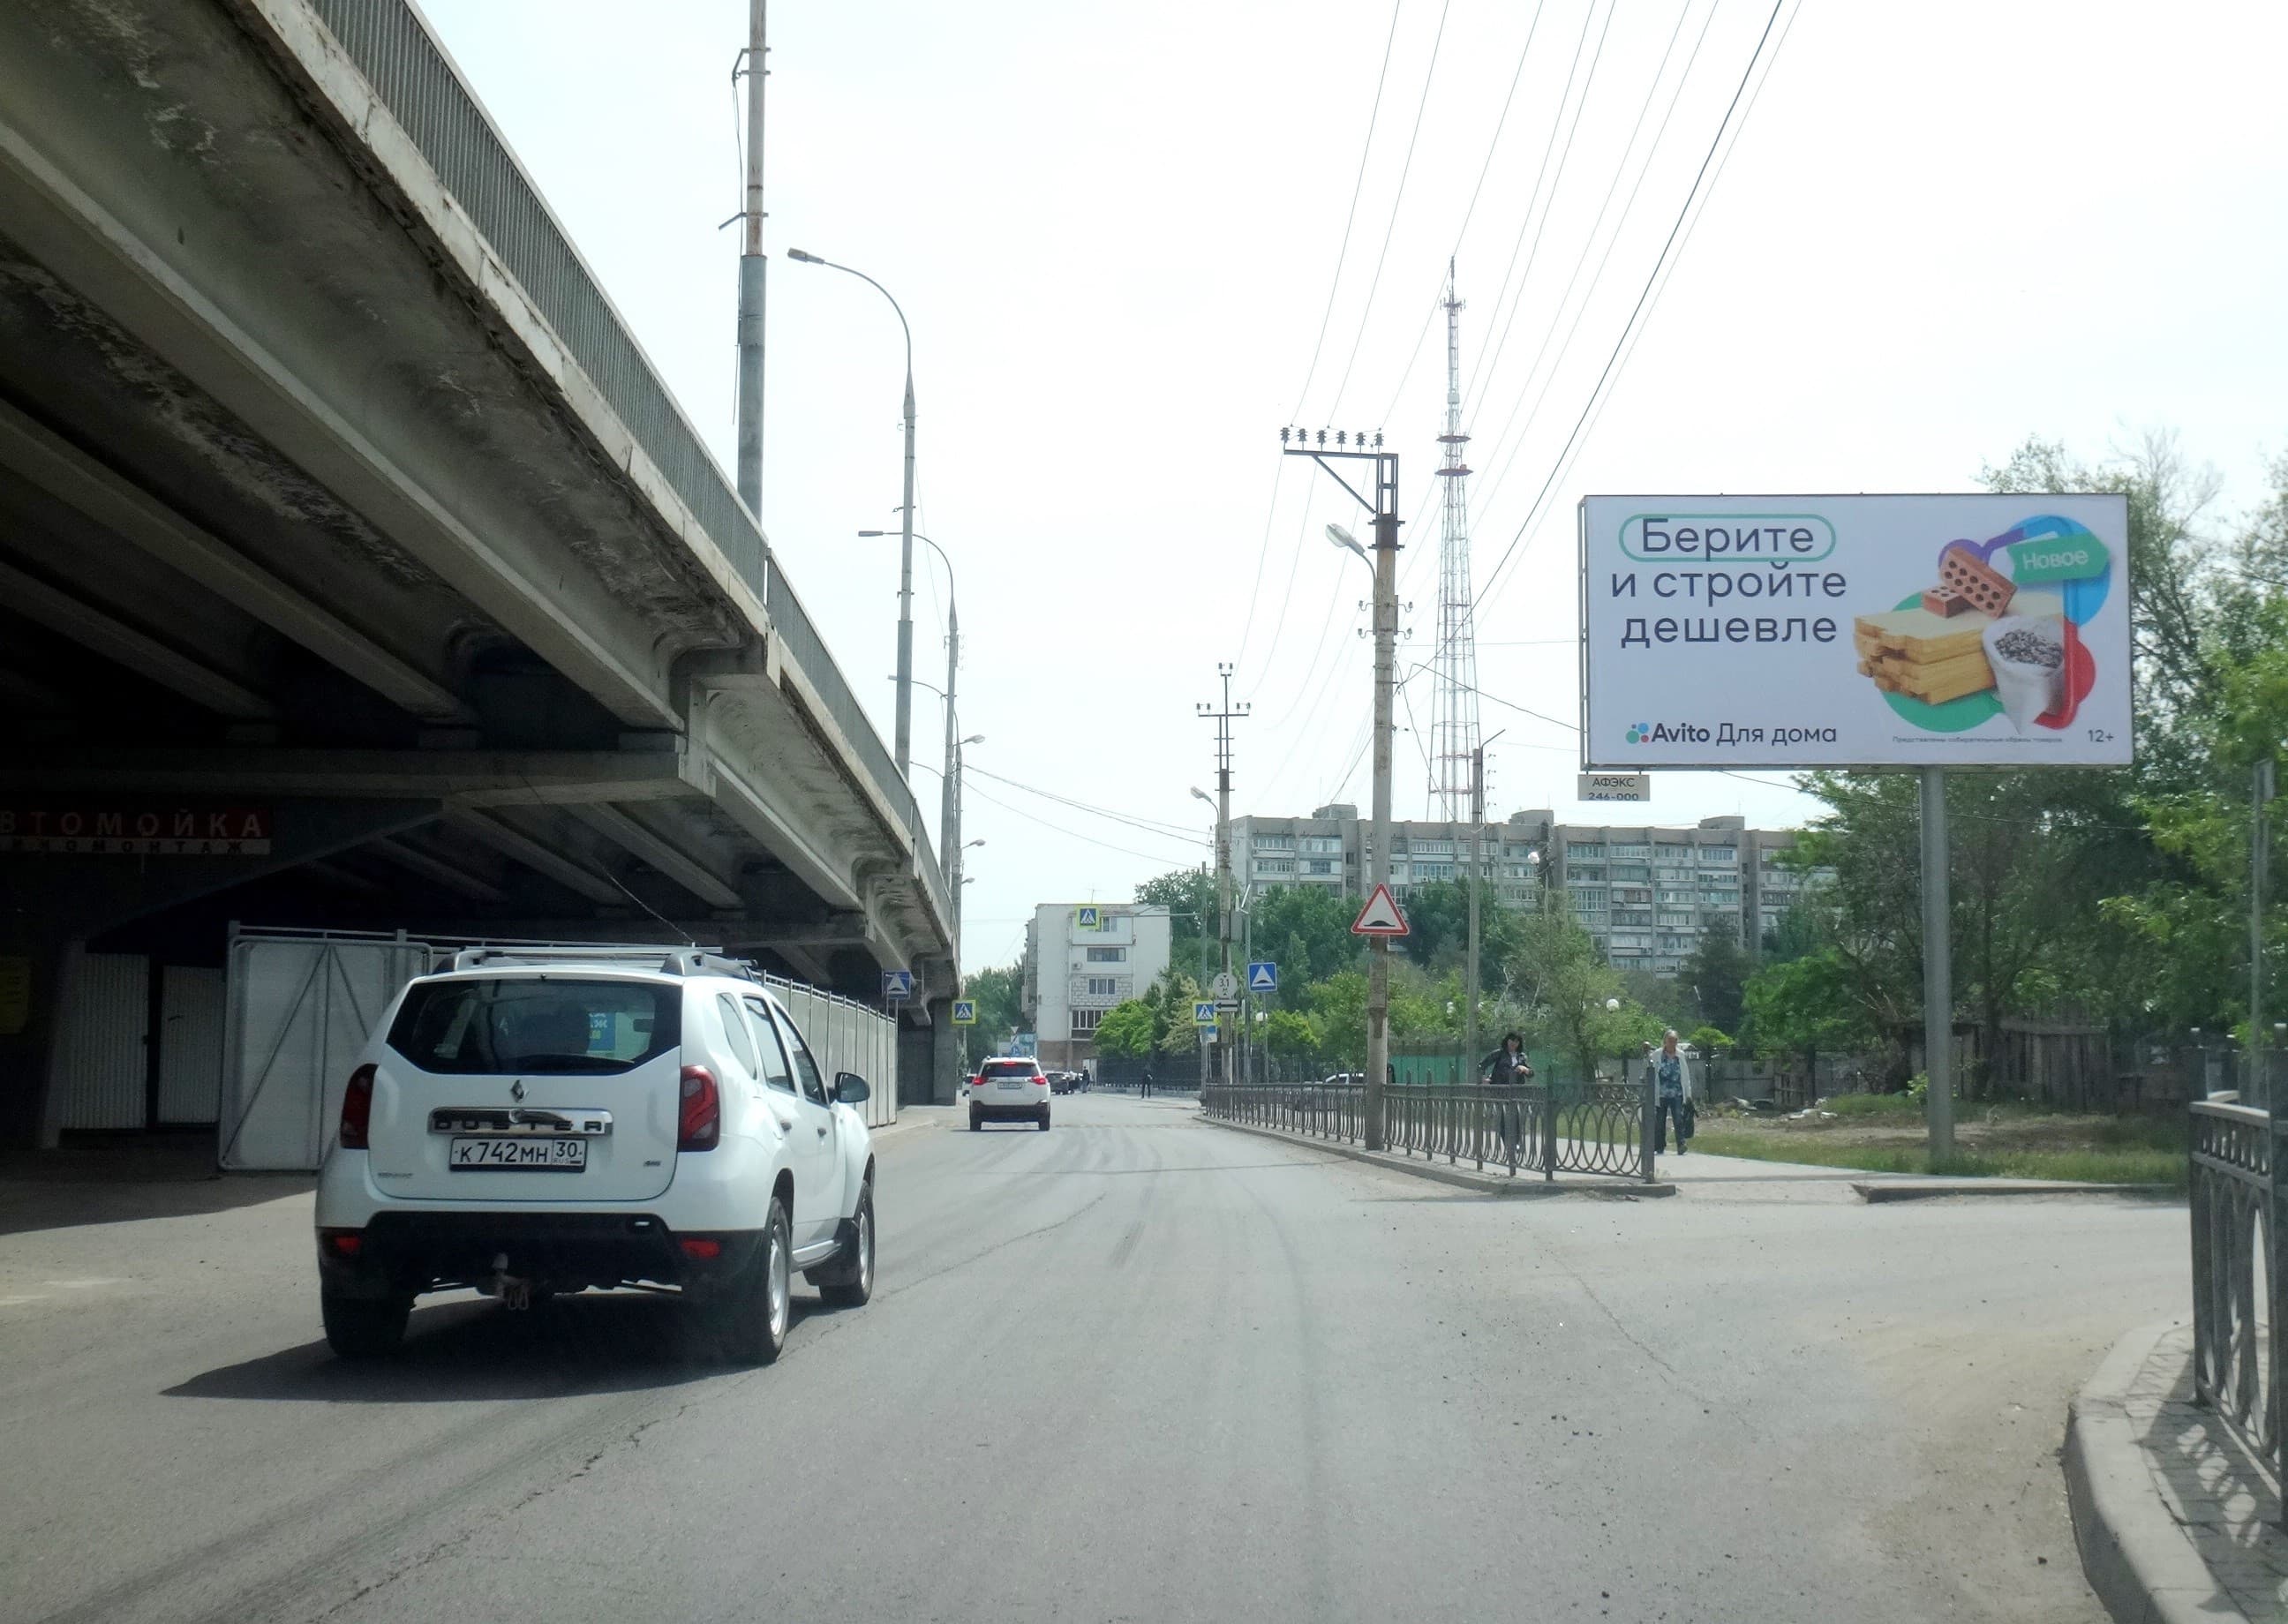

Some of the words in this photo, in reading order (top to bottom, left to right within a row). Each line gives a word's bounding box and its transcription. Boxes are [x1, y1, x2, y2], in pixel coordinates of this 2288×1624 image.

[1641, 517, 1814, 560] Берите
[2021, 546, 2089, 569] Новое
[1611, 573, 1637, 598] и
[1653, 561, 1847, 607] стройте
[1621, 617, 1837, 649] дешевле
[1652, 723, 1710, 744] Avito
[1716, 724, 1765, 747] Для
[1772, 726, 1837, 747] дома
[2088, 729, 2114, 743] 12+
[1592, 778, 1636, 787] АФЭКС
[1588, 792, 1639, 801] 246-000
[433, 1120, 603, 1132] DUSTER
[556, 1141, 578, 1158] 30
